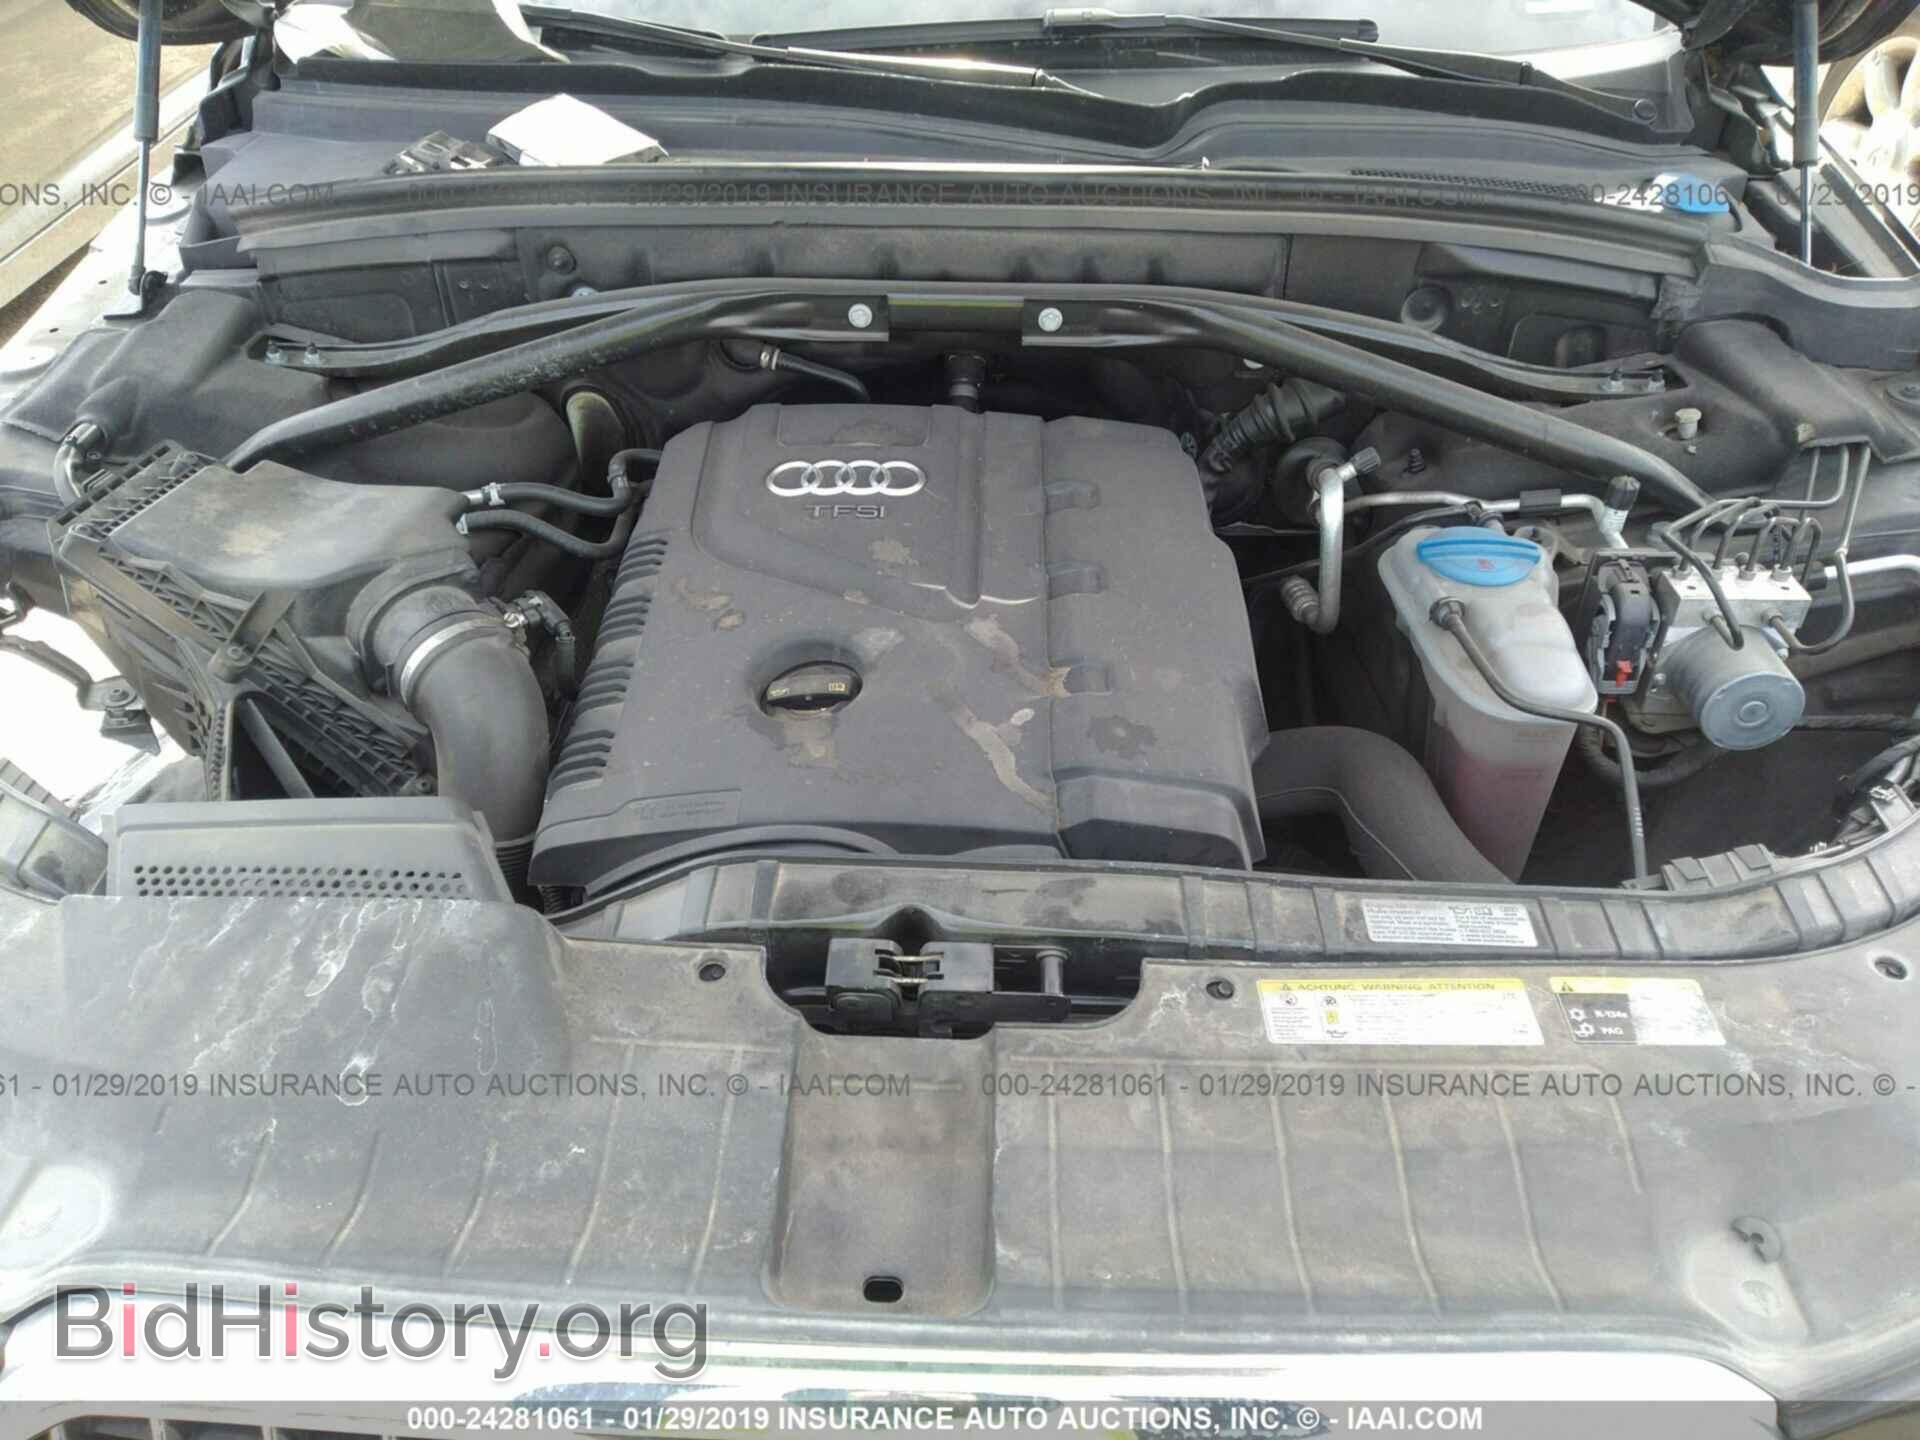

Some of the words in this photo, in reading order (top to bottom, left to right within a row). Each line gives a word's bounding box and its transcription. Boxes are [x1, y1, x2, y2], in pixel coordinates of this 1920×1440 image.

[803, 503, 886, 519] TFSI
[1361, 983, 1422, 991] WARNING
[1429, 983, 1495, 991] ATTENTION
